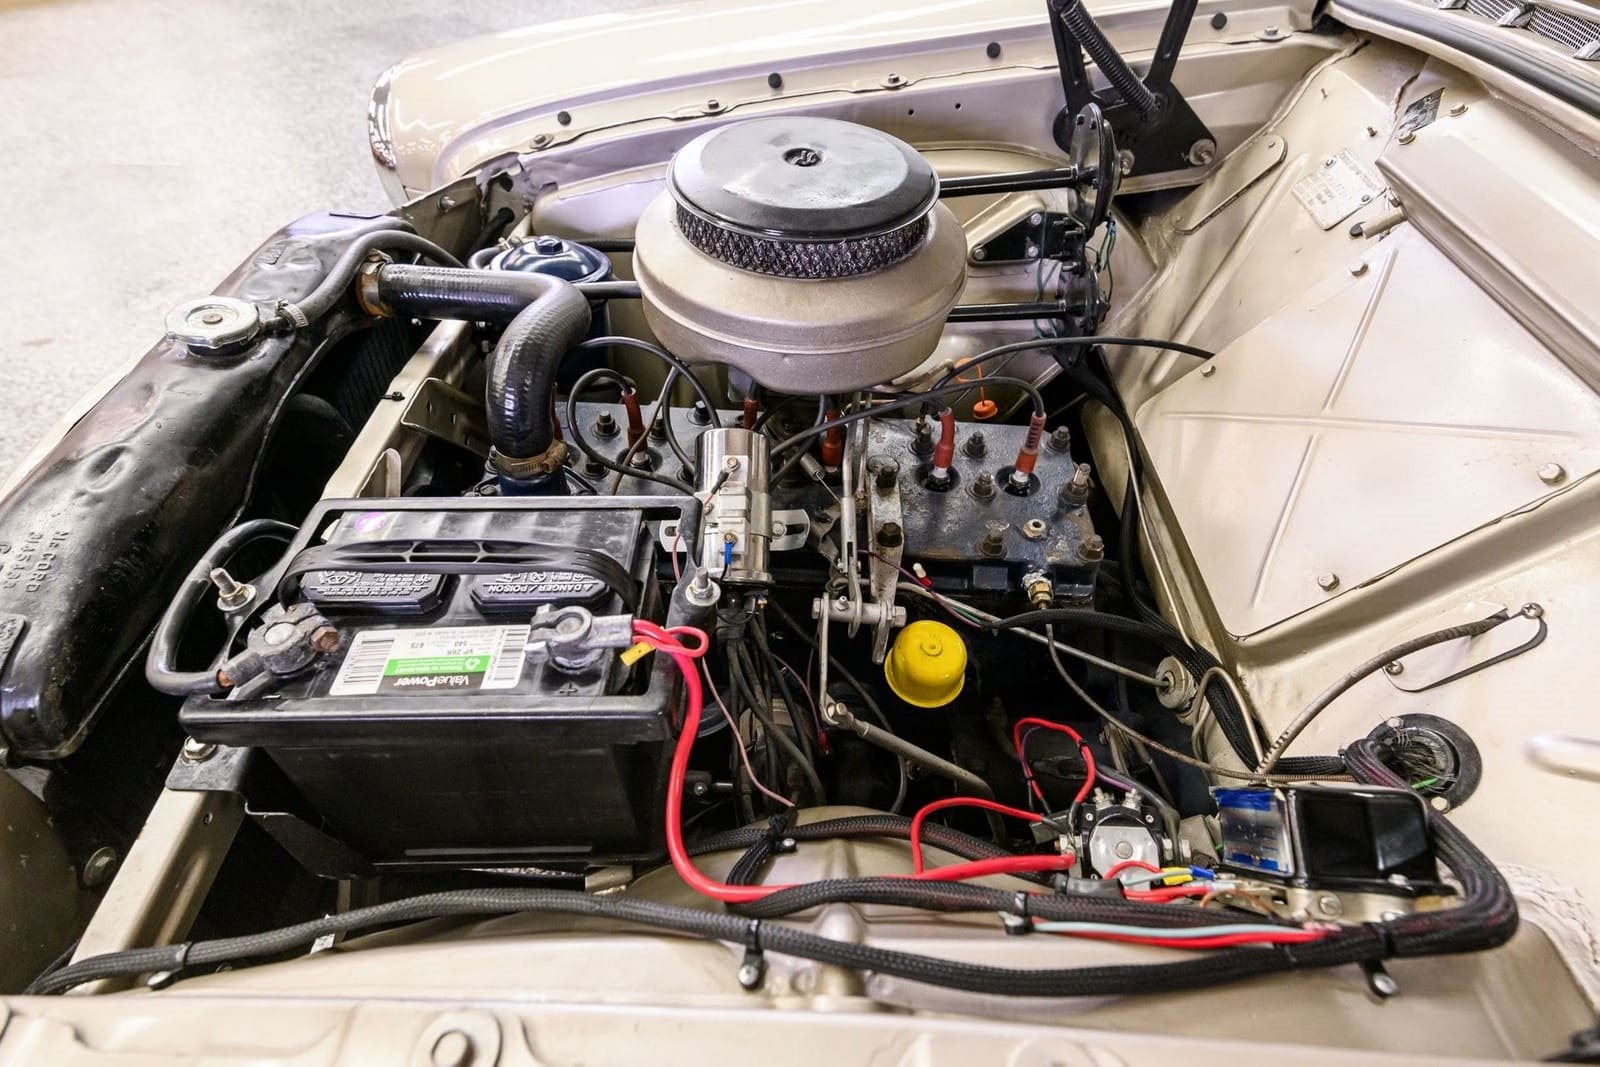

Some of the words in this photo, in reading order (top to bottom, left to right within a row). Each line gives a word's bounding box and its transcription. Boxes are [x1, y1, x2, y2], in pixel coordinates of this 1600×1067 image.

[488, 584, 528, 593] POISON
[539, 583, 582, 592] DANGER
[393, 674, 470, 687] ValuePower
